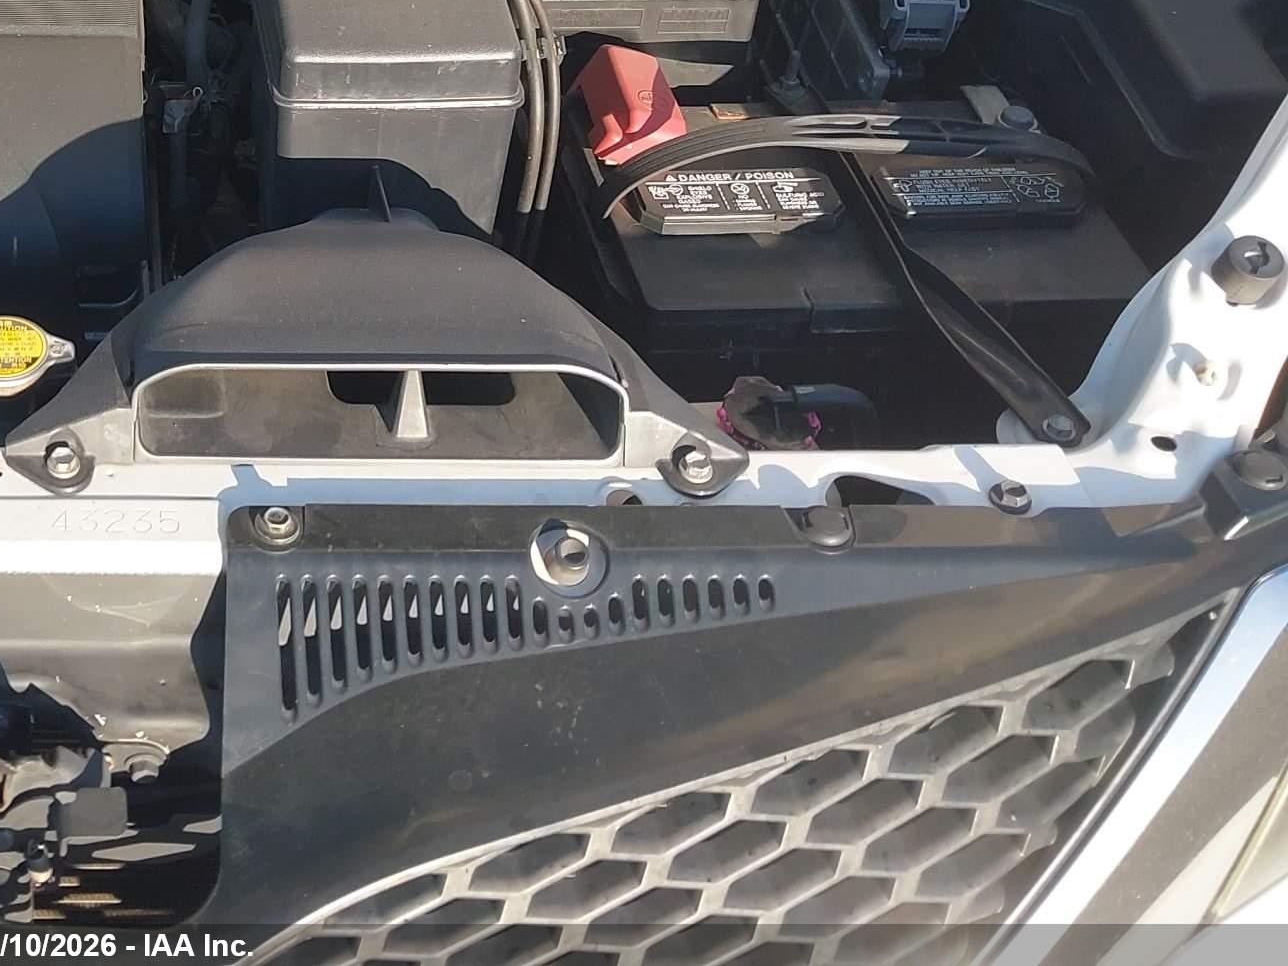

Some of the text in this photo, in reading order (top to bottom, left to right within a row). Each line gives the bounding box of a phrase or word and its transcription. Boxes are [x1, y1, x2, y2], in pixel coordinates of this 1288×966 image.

[678, 173, 732, 182] DANGER
[745, 171, 794, 180] POISON
[49, 507, 181, 534] 43235
